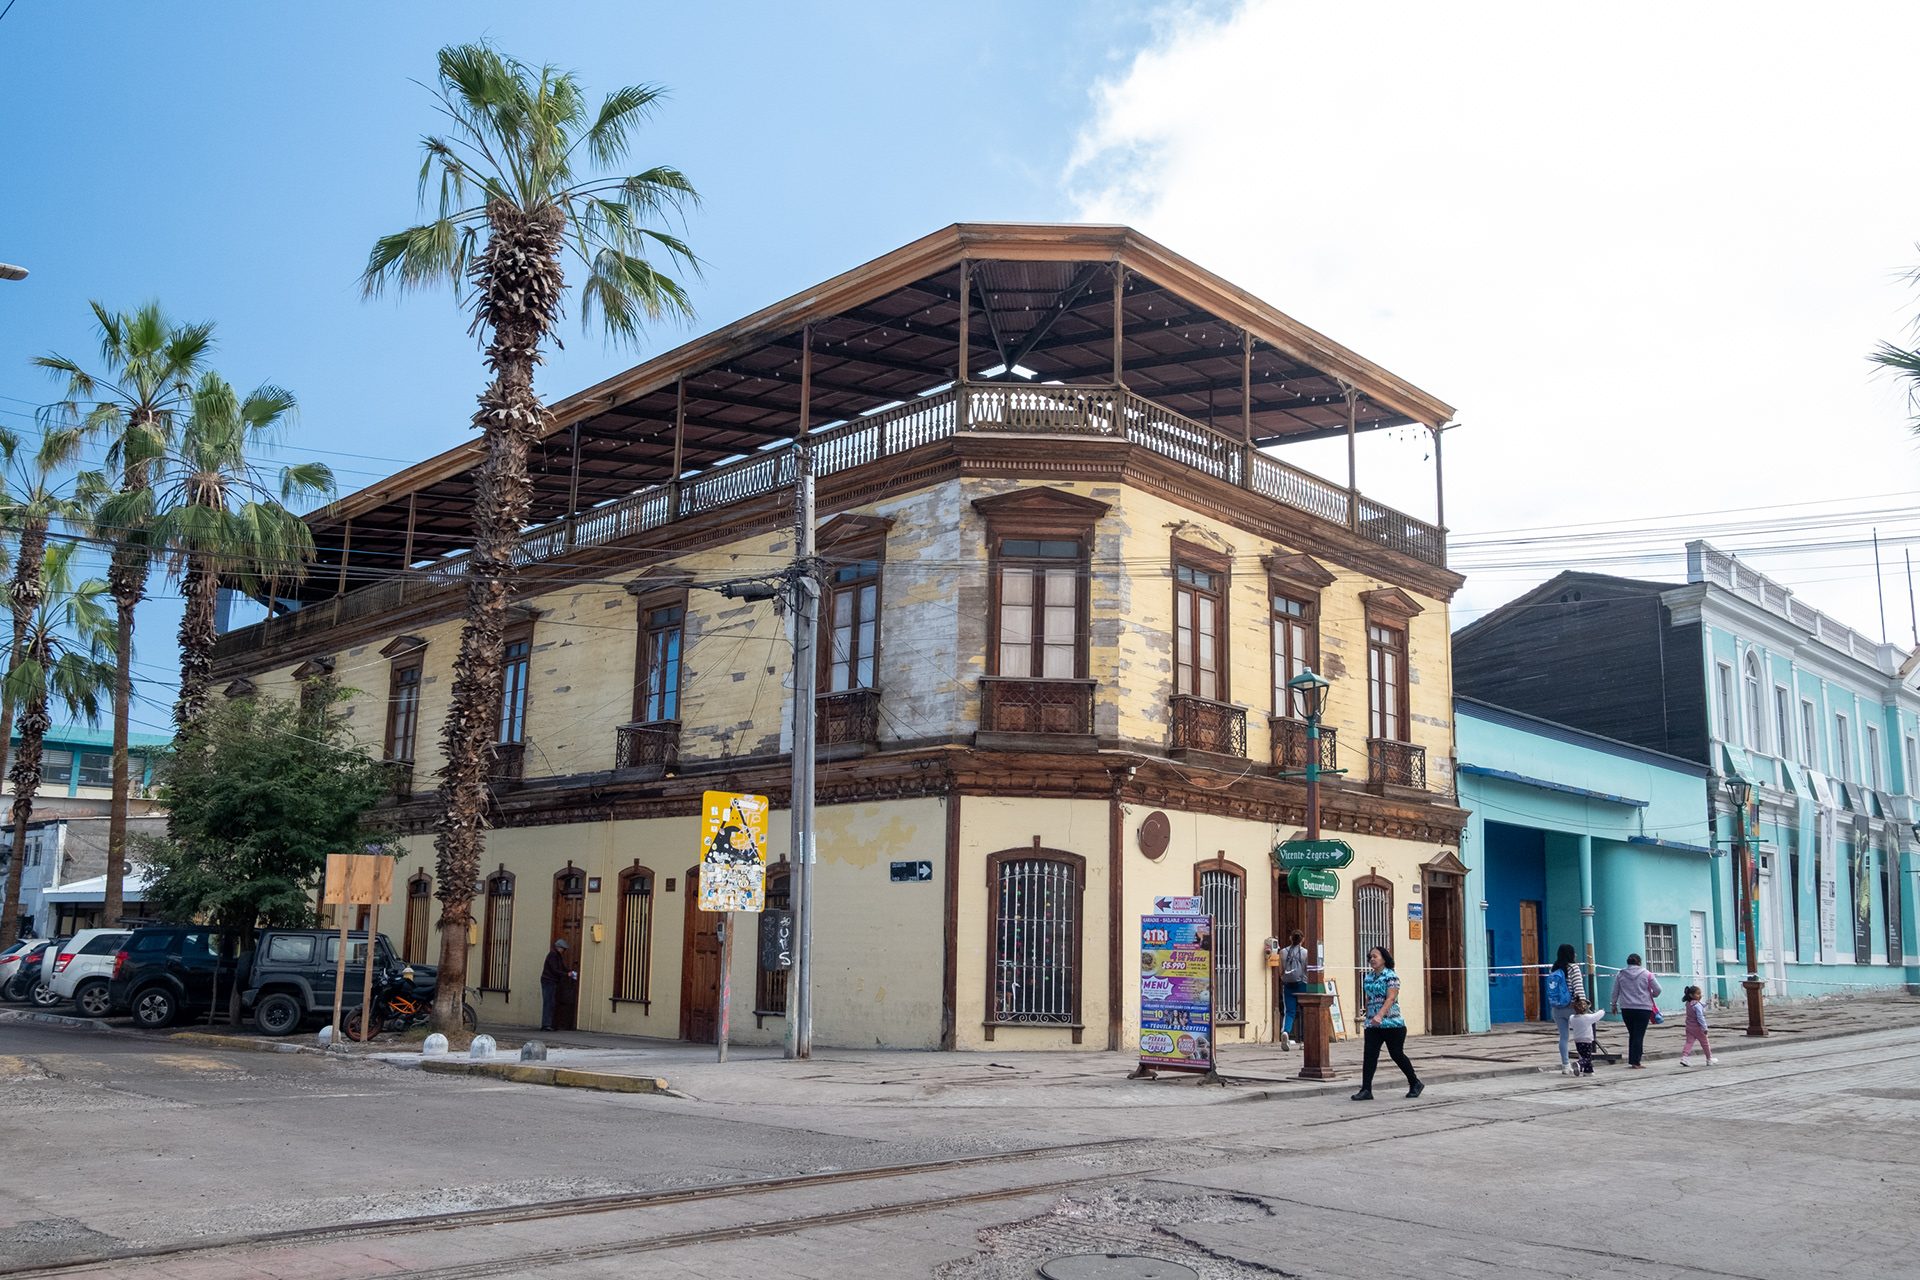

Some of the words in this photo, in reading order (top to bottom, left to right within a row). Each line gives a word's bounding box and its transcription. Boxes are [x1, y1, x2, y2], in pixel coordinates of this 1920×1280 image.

[1280, 849, 1304, 860] Vicente
[1306, 848, 1330, 861] Zegers
[1191, 899, 1199, 908] BAR
[1143, 929, 1168, 941] 4TRI
[1170, 951, 1178, 962] 4
[1162, 961, 1186, 969] $5.990
[1154, 1010, 1164, 1018] 10
[1202, 1013, 1210, 1022] 15
